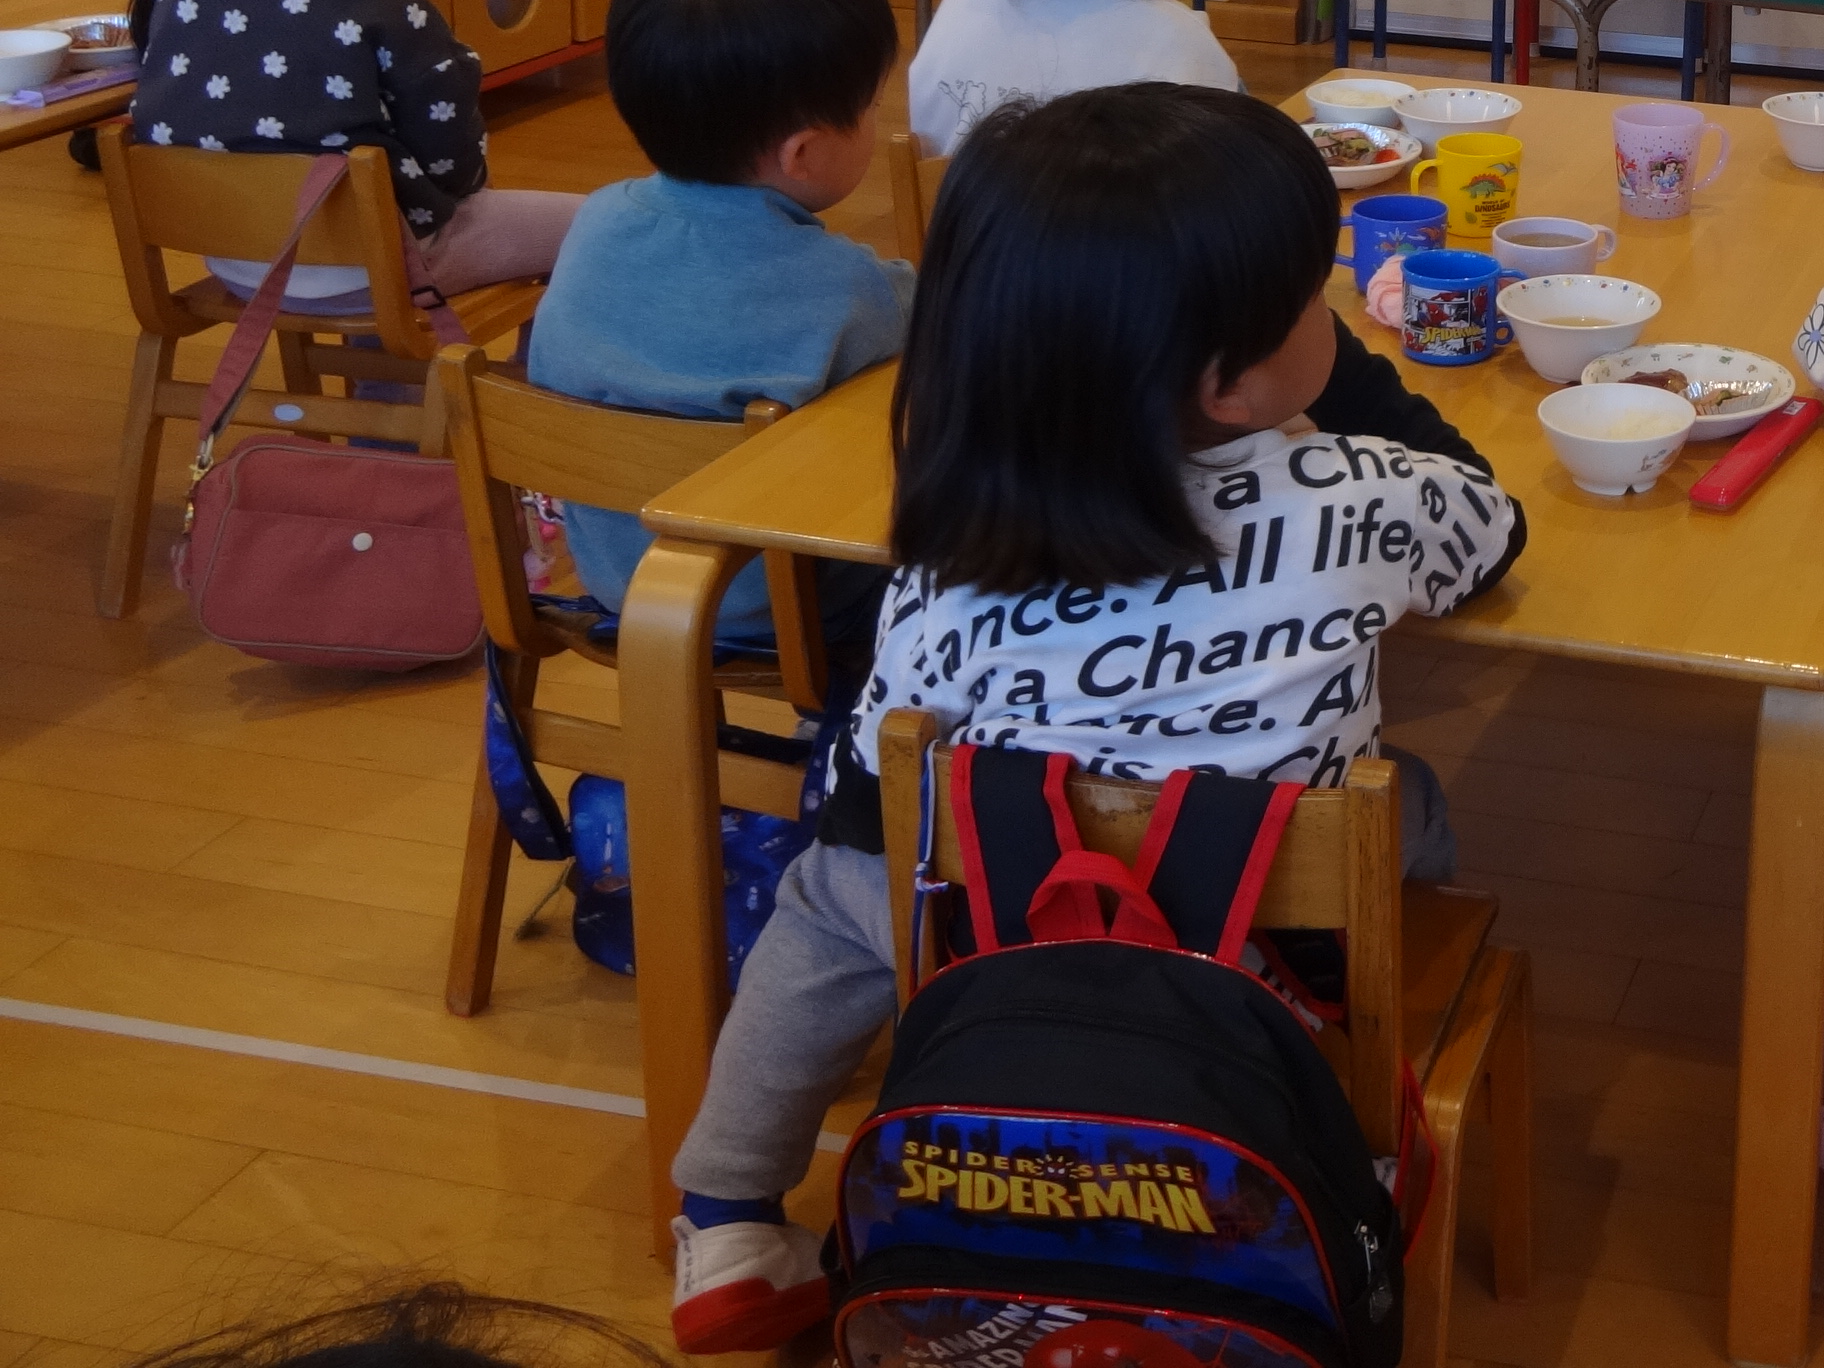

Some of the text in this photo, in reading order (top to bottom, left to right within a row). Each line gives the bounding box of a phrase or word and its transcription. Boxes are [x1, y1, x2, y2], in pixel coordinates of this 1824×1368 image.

[1213, 469, 1261, 511] a
[1312, 498, 1413, 573] life
[1006, 669, 1045, 708] a
[1077, 601, 1387, 699] Chance
[904, 1141, 1195, 1183] SPIDER SENSE
[898, 1158, 1218, 1234] SPIDER-MAN
[927, 1302, 1040, 1360] AMAZIN
